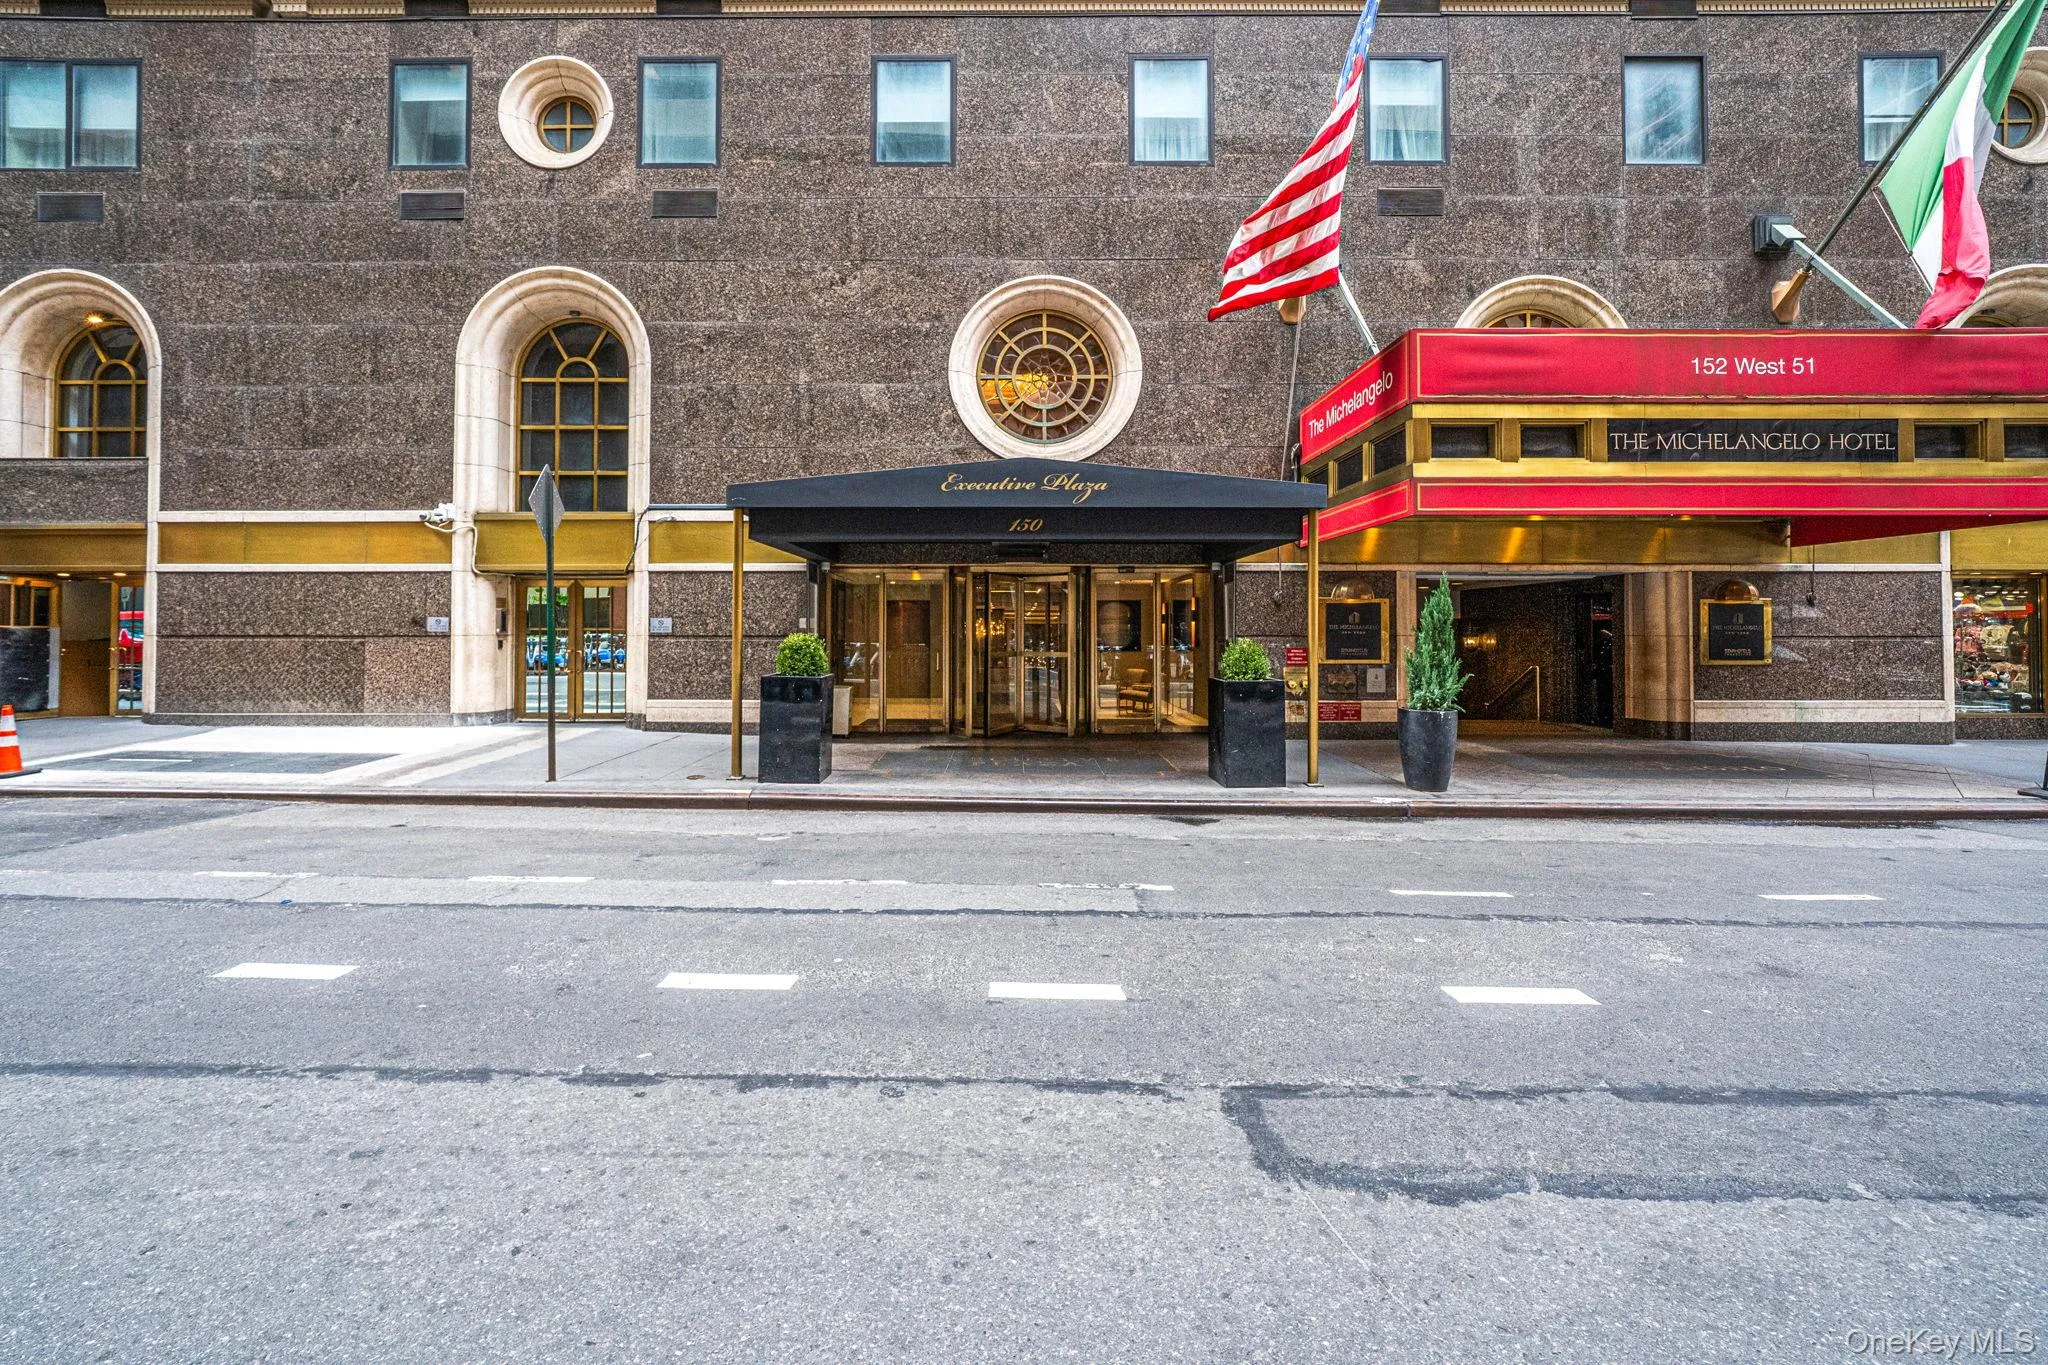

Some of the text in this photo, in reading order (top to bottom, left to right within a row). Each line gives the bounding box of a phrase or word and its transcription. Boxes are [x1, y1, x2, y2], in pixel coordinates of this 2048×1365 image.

[1691, 357, 1815, 375] 152 West 51
[1308, 371, 1393, 439] The Michelangelo
[1609, 432, 1897, 451] THE MICHELANGELO HOTEL
[940, 472, 1109, 505] Executive Plaza
[1008, 518, 1043, 532] 150
